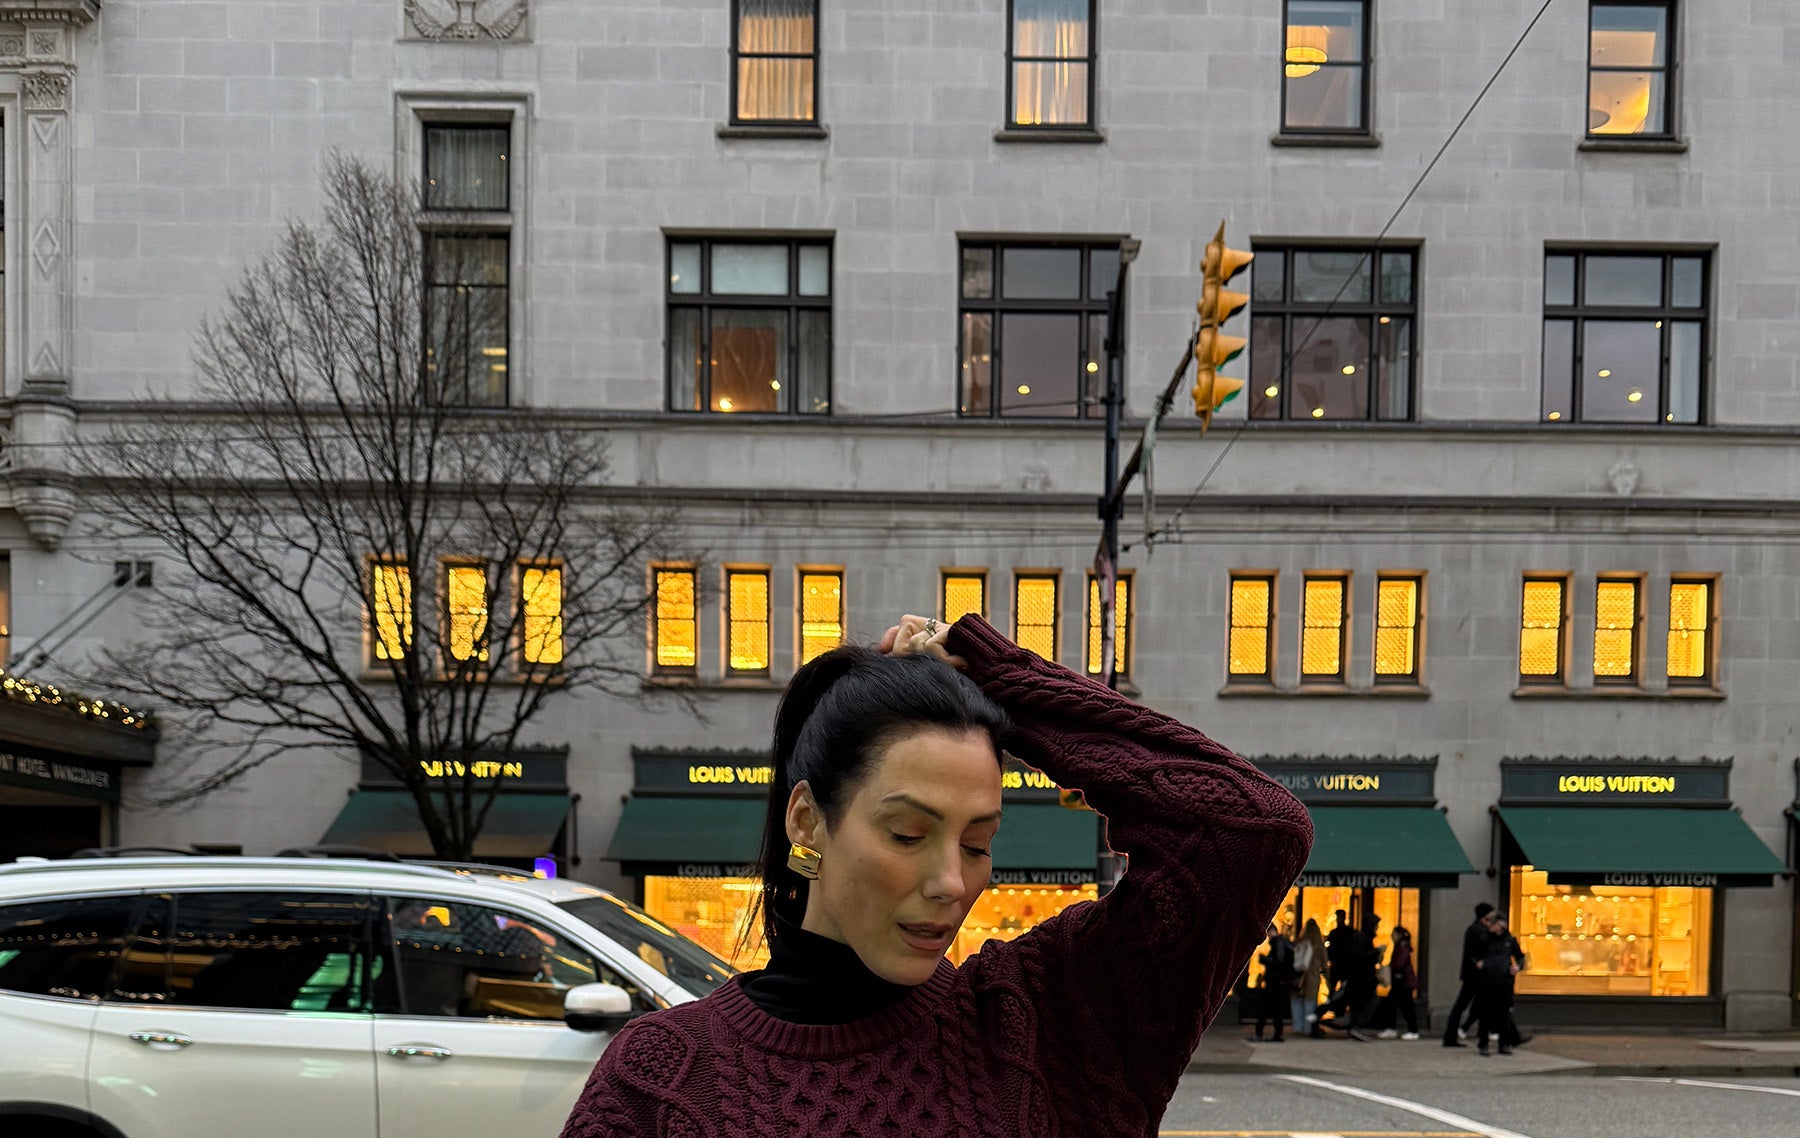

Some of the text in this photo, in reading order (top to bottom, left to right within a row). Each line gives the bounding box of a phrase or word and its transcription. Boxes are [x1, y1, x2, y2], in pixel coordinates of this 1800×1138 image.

[689, 766, 735, 783] LOUIS
[1313, 774, 1380, 791] VUITTON
[1558, 776, 1675, 793] LOUIS VUITTON
[678, 865, 721, 876] LOUIS
[990, 872, 1094, 883] OUIS VUITTON
[1336, 874, 1401, 888] VUITTON
[1604, 873, 1718, 886] LOUIS VUITTON
